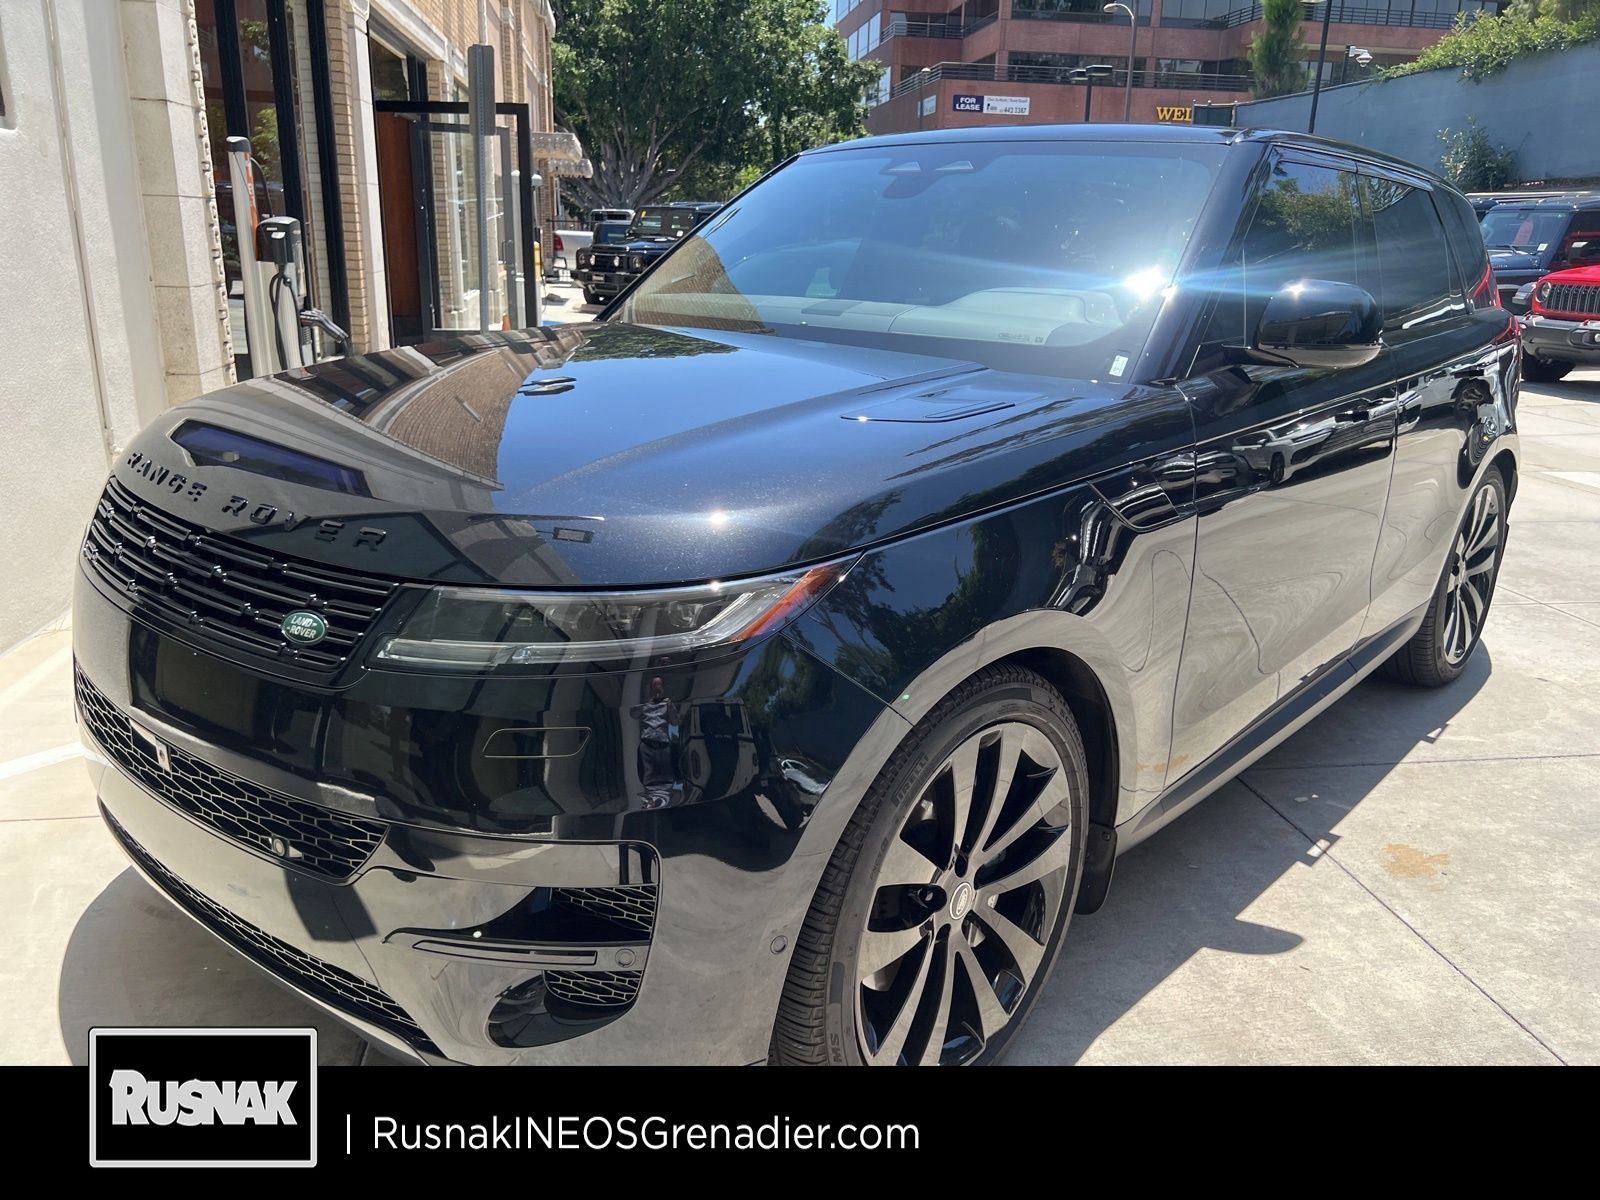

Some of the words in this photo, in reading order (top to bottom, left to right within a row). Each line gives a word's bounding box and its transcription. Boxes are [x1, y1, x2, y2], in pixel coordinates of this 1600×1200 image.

[955, 103, 981, 111] LEASE
[127, 452, 208, 502] RANGE
[221, 495, 387, 552] ROVER
[290, 615, 314, 628] LAND
[289, 624, 317, 639] ROVER
